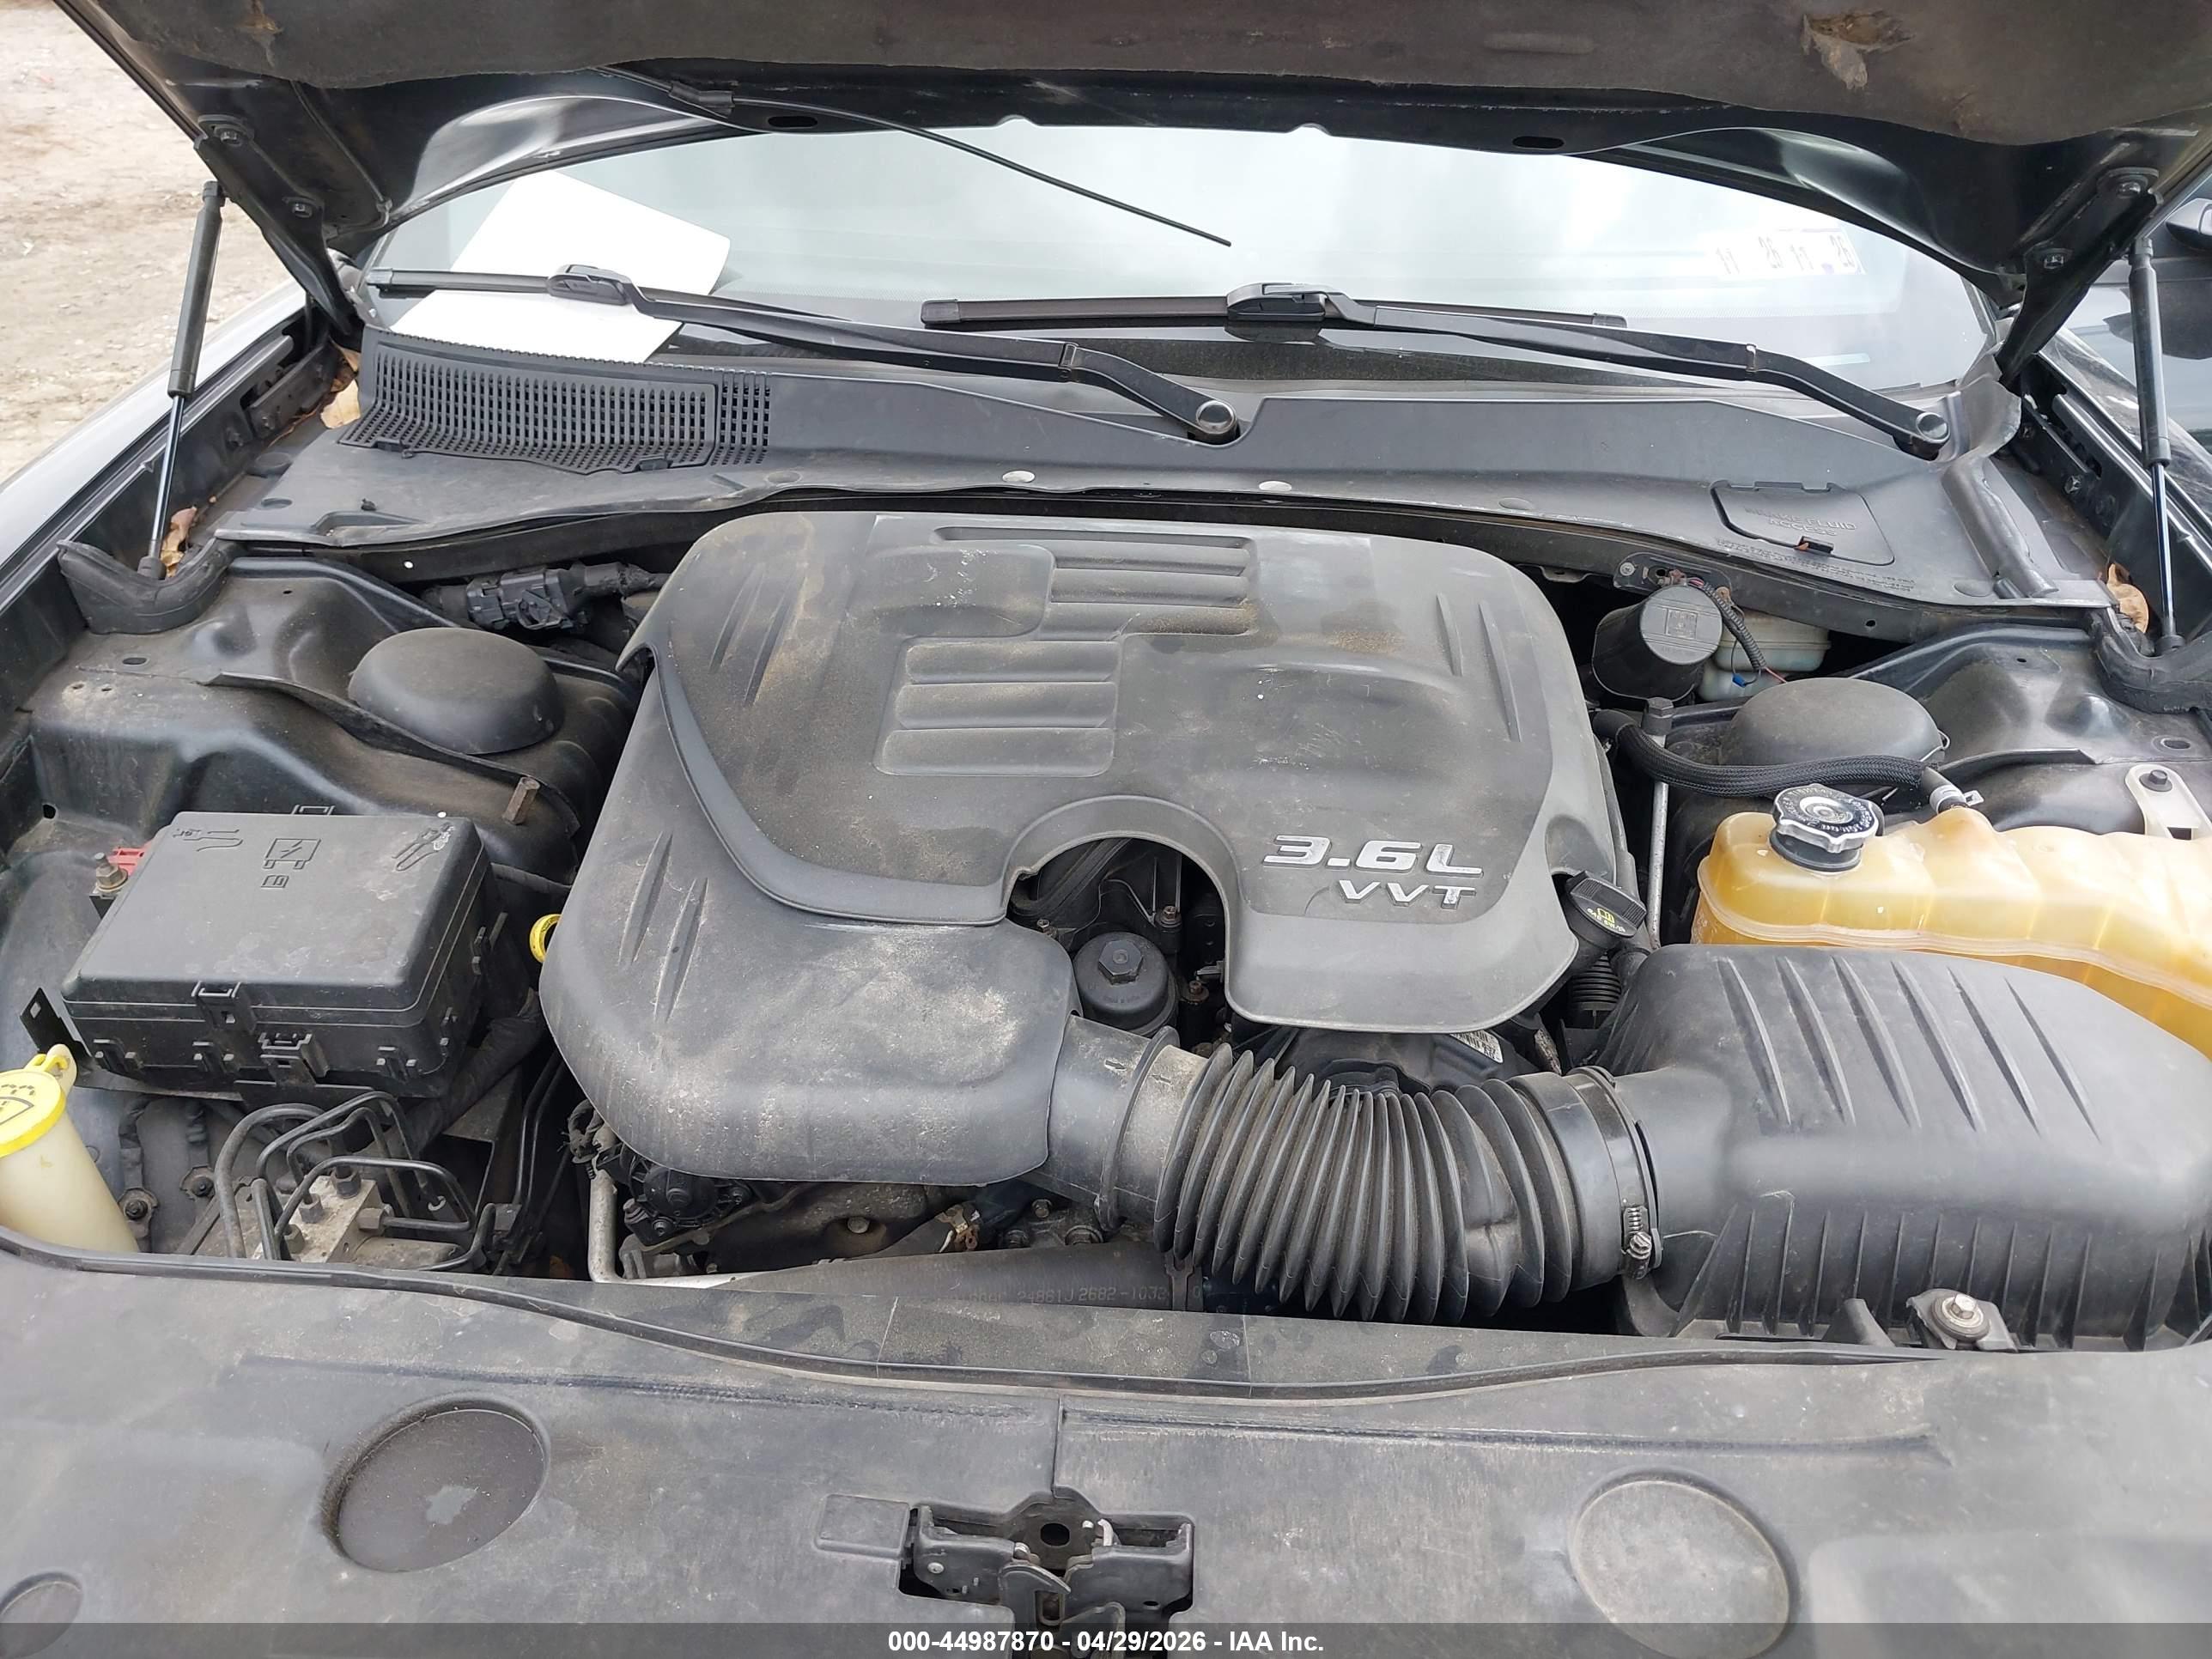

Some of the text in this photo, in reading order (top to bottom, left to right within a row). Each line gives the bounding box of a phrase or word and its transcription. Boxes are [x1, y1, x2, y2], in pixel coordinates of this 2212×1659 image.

[1768, 518, 1838, 537] ACCESS
[1805, 517, 1857, 531] FLUID
[1262, 834, 1484, 878] 3.6L
[1339, 879, 1476, 910] VVT
